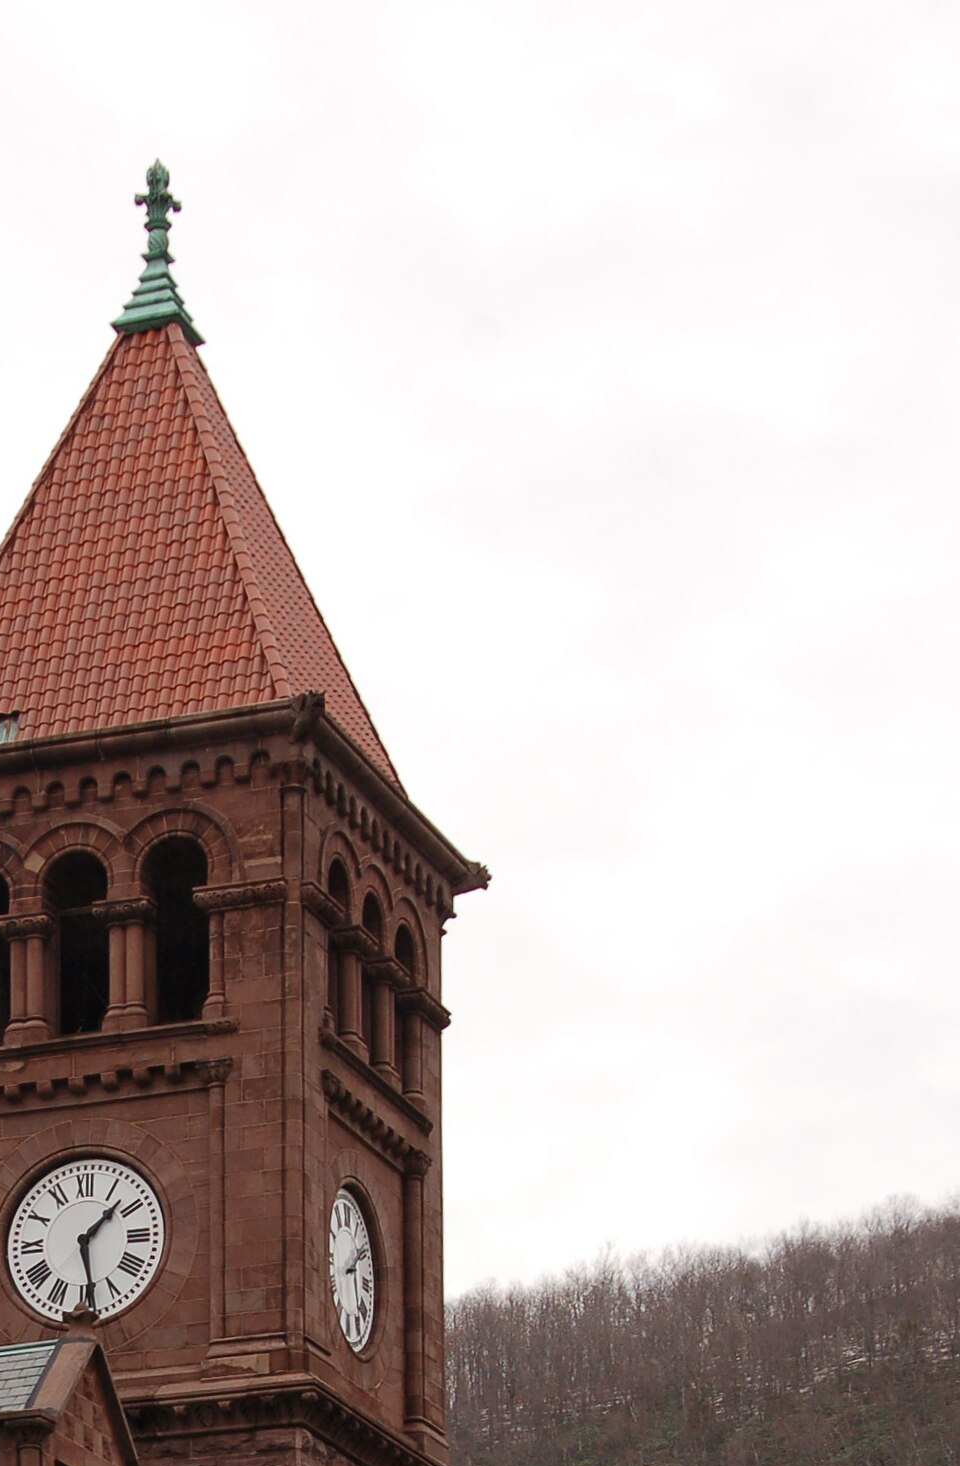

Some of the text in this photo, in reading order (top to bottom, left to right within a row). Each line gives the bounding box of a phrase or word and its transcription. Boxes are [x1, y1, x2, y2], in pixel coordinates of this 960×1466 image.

[77, 1173, 94, 1199] XII
[48, 1183, 69, 1209] XI
[120, 1199, 143, 1218] II
[28, 1210, 50, 1227] X
[127, 1228, 150, 1243] III
[21, 1239, 43, 1255] IX
